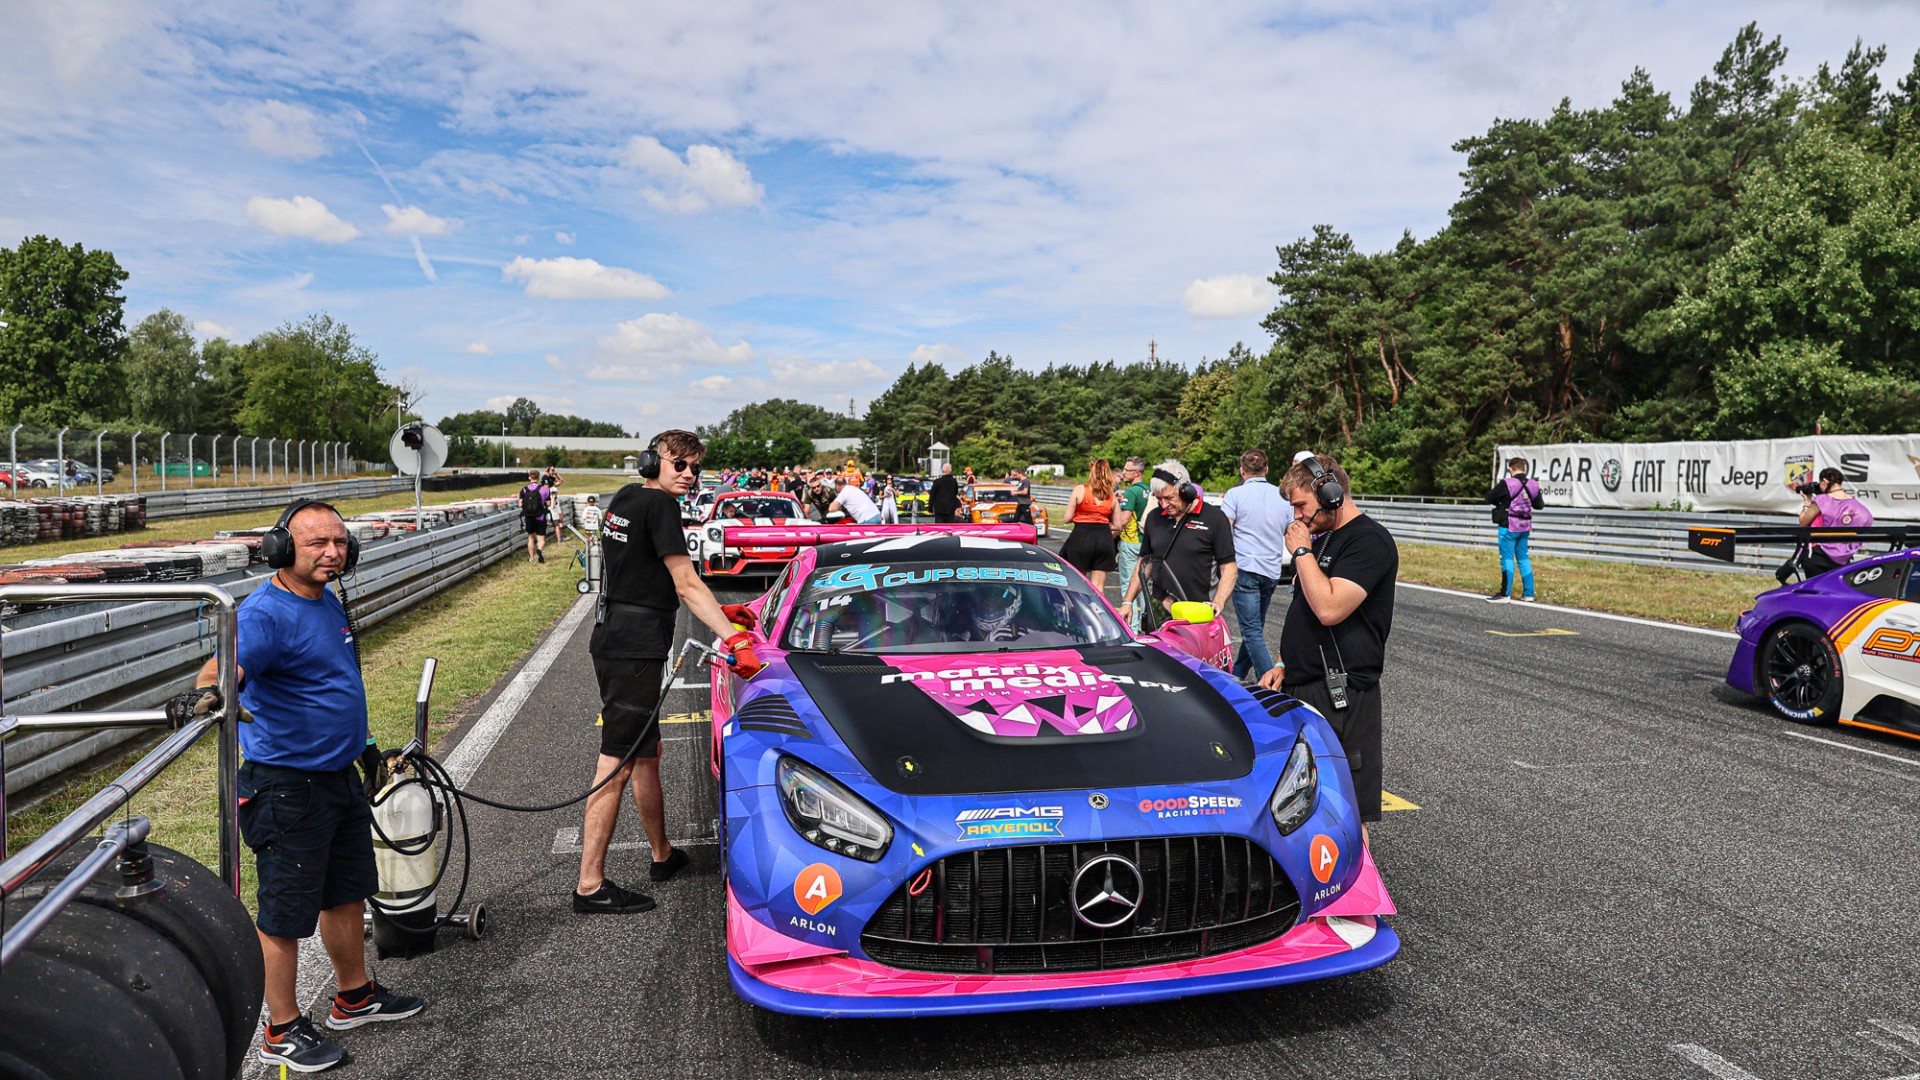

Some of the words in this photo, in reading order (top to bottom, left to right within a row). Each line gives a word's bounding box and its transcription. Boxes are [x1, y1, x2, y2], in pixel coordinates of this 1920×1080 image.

[1632, 460, 1666, 493] FIAT
[1677, 459, 1711, 494] FIAT
[1721, 466, 1768, 489] Jeep
[1843, 489, 1880, 499] EAT
[1891, 492, 1920, 500] CU
[883, 567, 955, 588] CUP
[956, 567, 1068, 587] SERIES
[818, 594, 852, 611] 14
[881, 664, 1074, 684] matrix
[950, 670, 1136, 692] media
[1022, 684, 1109, 695] RESELLER
[1773, 699, 1808, 719] MICHELIN
[994, 806, 1063, 817] AMG
[967, 822, 1053, 836] RAVENOL
[1319, 844, 1333, 871] A
[804, 875, 828, 899] A
[1314, 882, 1341, 902] ARLON
[790, 916, 836, 936] ARLON
